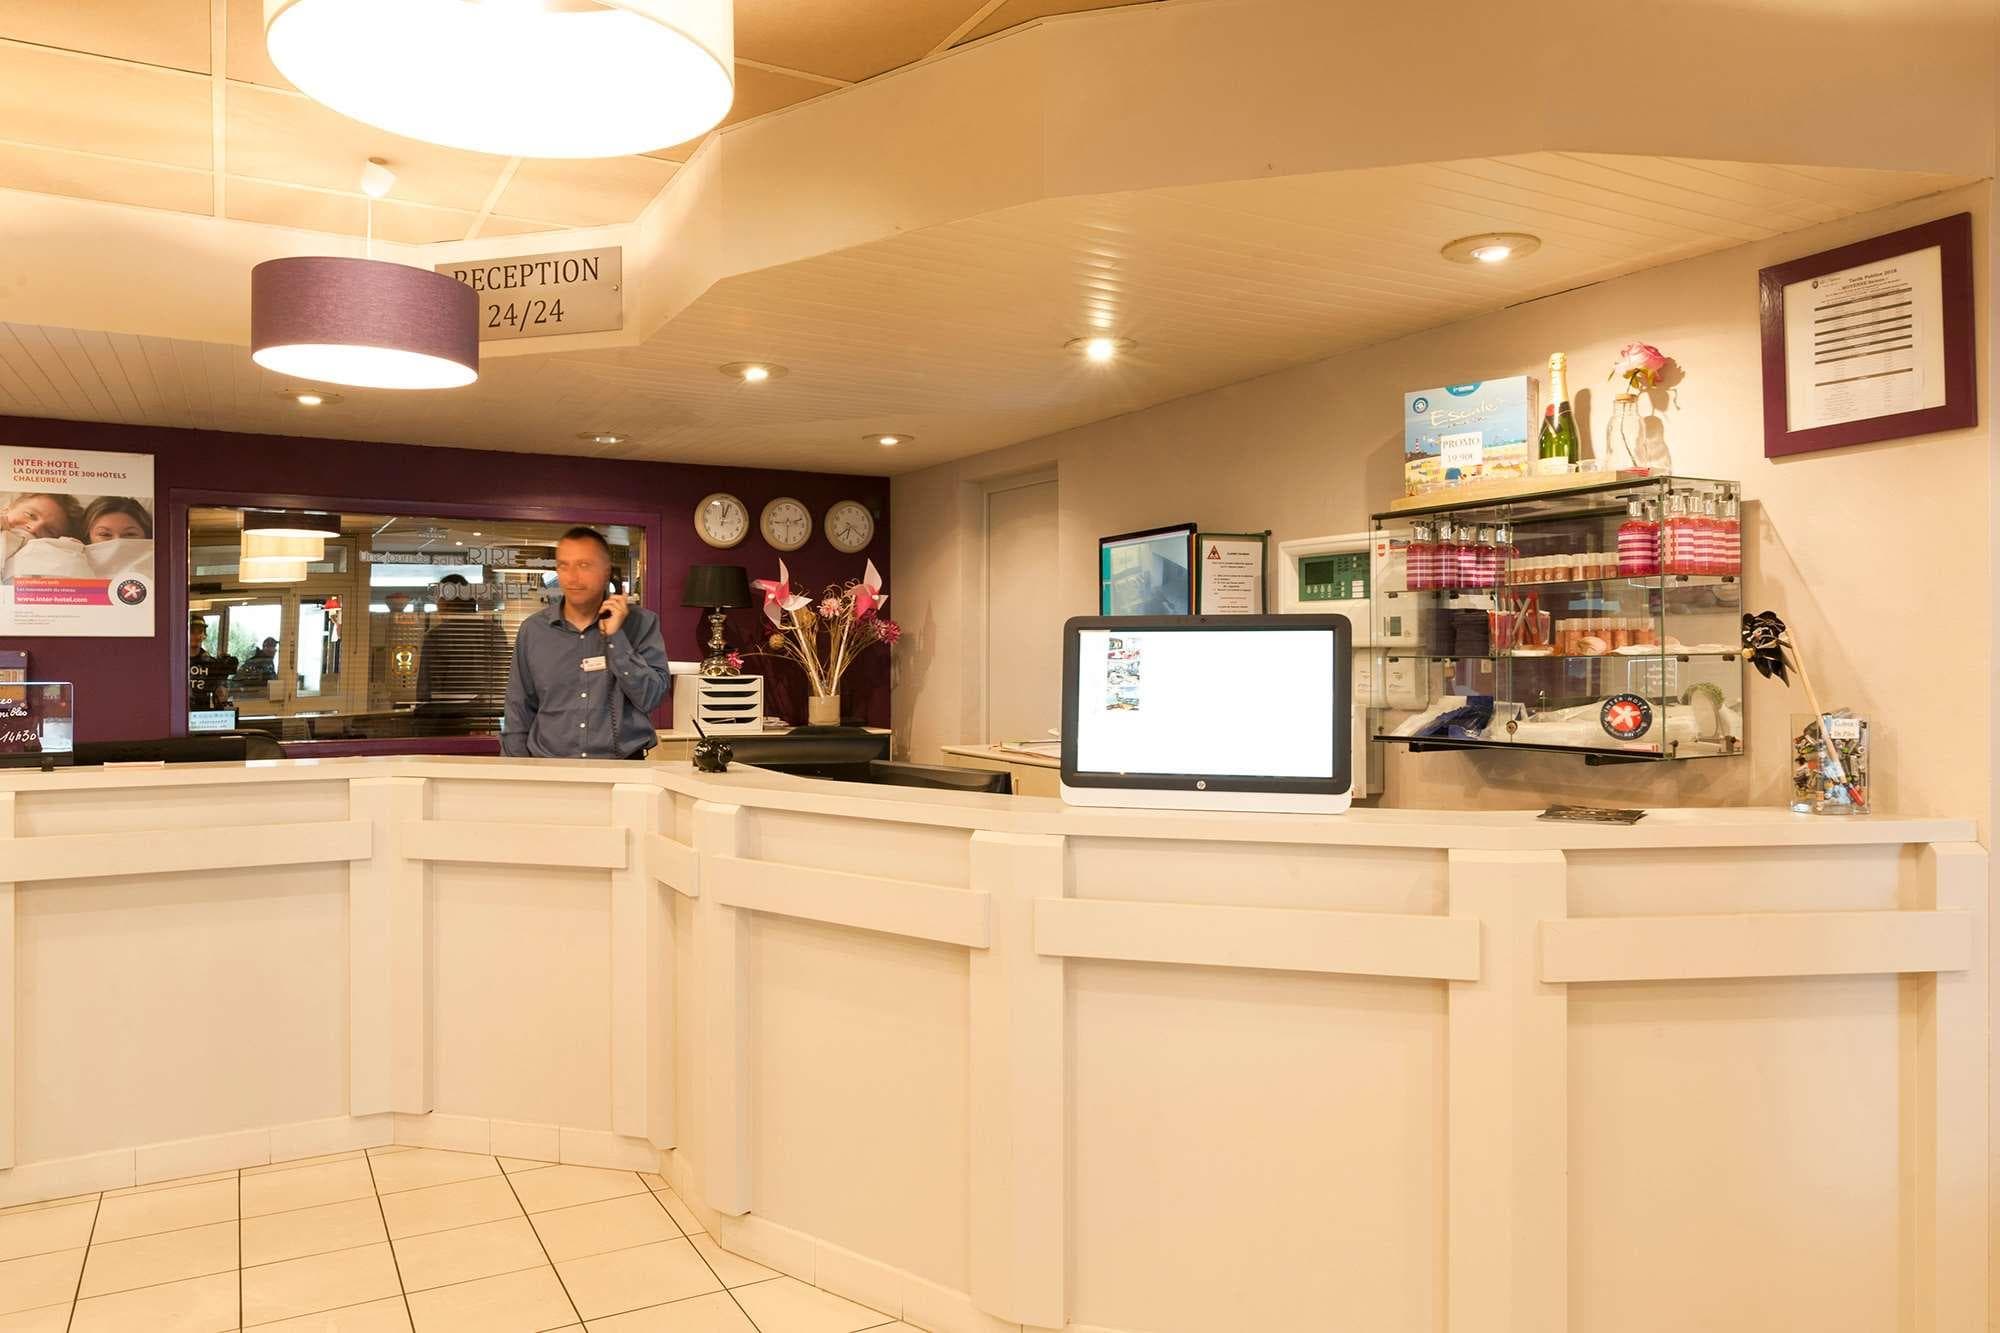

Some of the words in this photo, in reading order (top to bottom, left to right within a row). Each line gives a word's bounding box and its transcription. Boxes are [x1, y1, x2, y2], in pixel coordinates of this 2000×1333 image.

[487, 298, 565, 332] 24/24
[1442, 437, 1480, 449] PROMO
[13, 458, 80, 469] INTER-HOTEL
[13, 475, 68, 484] CHALEUREUX
[81, 470, 96, 478] 300
[467, 546, 520, 565] RIRE
